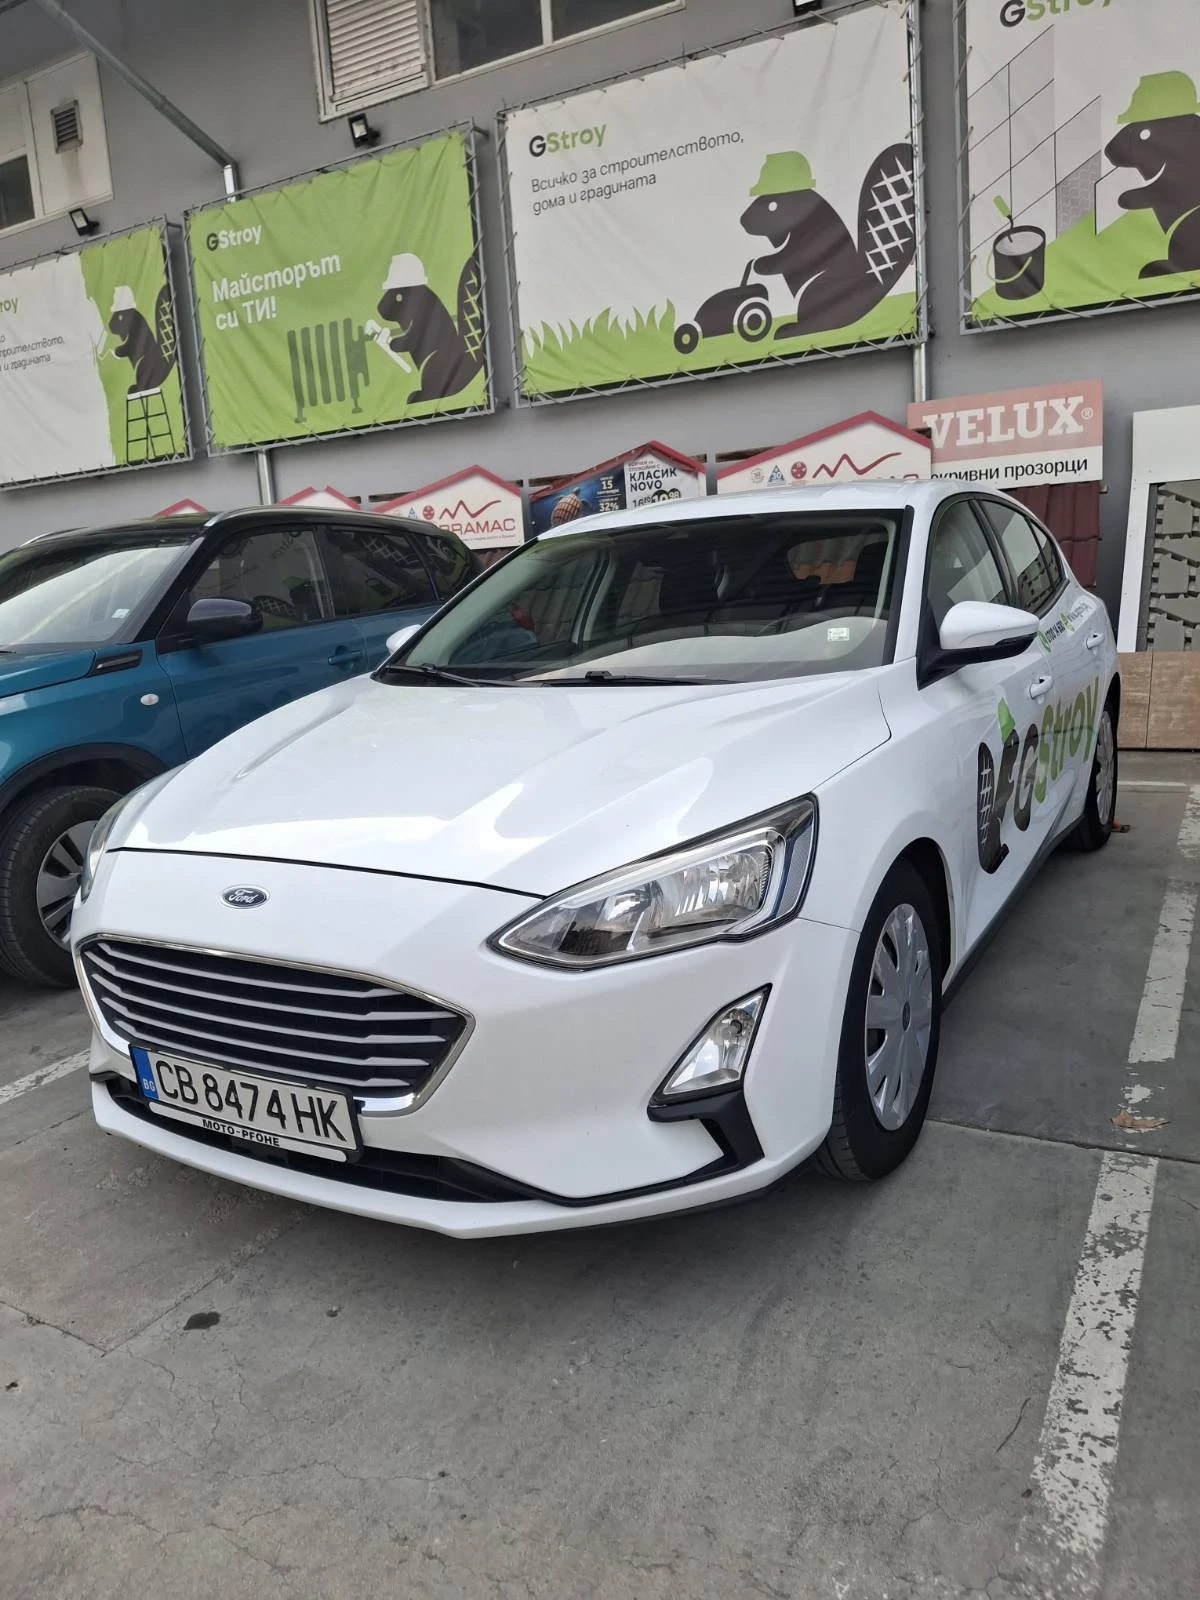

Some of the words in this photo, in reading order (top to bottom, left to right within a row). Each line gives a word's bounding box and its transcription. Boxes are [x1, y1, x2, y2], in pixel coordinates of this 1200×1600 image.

[1000, 0, 1111, 28] GStr
[529, 124, 607, 158] GStroy
[531, 171, 577, 193] Всичко
[581, 164, 597, 185] за
[600, 131, 744, 174] строителството,
[533, 193, 565, 216] дома
[568, 190, 577, 204] и
[579, 173, 657, 204] градината
[206, 224, 262, 252] GStroy
[211, 255, 340, 303] Майсторът
[215, 310, 239, 330] си
[241, 296, 277, 324] ТИ!
[629, 467, 677, 482] КЛАСИК
[1004, 458, 1088, 481] прозорци
[602, 480, 613, 490] 15
[630, 480, 662, 493] NOVO
[1014, 676, 1099, 832] GStroy
[228, 889, 259, 904] Ford
[143, 1078, 156, 1092] BG
[202, 1118, 280, 1147] MOTO-PFOHE
